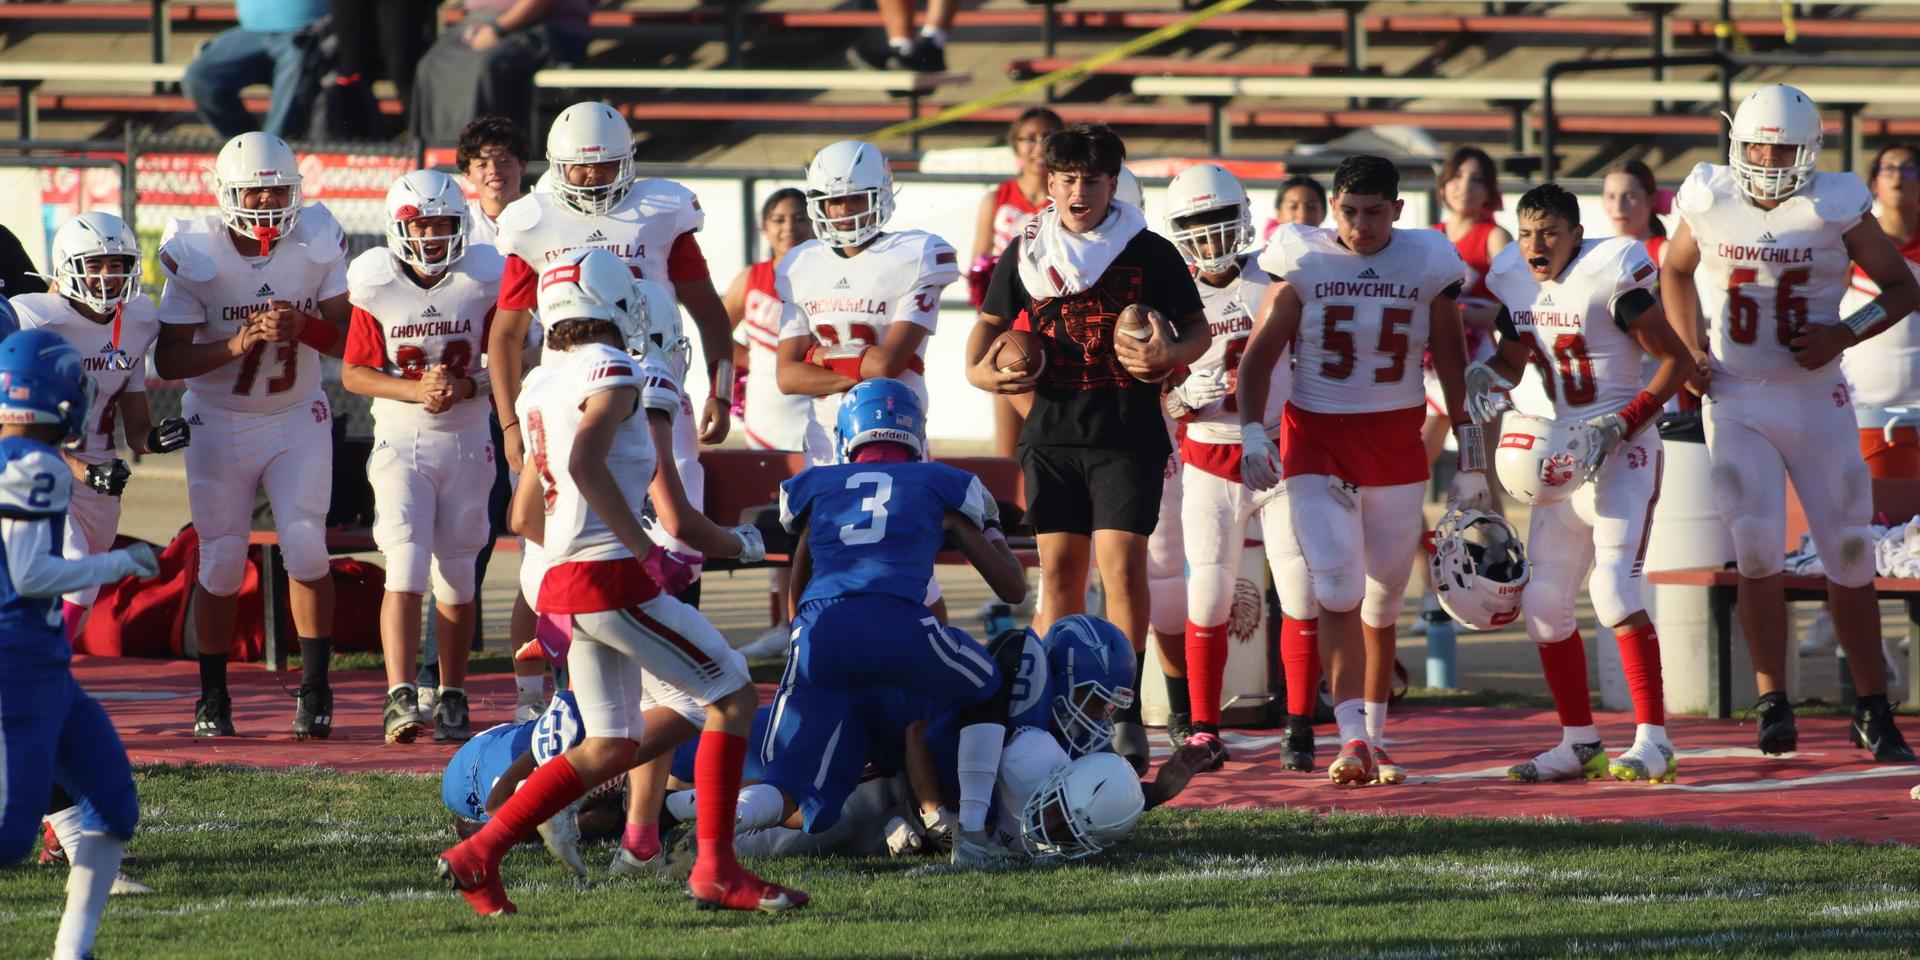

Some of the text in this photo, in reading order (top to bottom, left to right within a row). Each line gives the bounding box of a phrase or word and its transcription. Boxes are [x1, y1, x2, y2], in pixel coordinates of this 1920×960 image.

[1718, 243, 1813, 262] CHOWCHILLA
[1315, 281, 1419, 302] CHOWCHILLA
[222, 297, 312, 321] CHOWLA
[1726, 266, 1812, 348] 66
[391, 319, 472, 339] CHOWCHILLA
[1513, 310, 1582, 328] CHOWCHILLA
[1319, 304, 1414, 383] 55
[875, 408, 883, 420] 3
[870, 430, 909, 441] Riddell
[28, 472, 56, 508] 2
[839, 471, 894, 546] 3
[537, 709, 564, 759] 52
